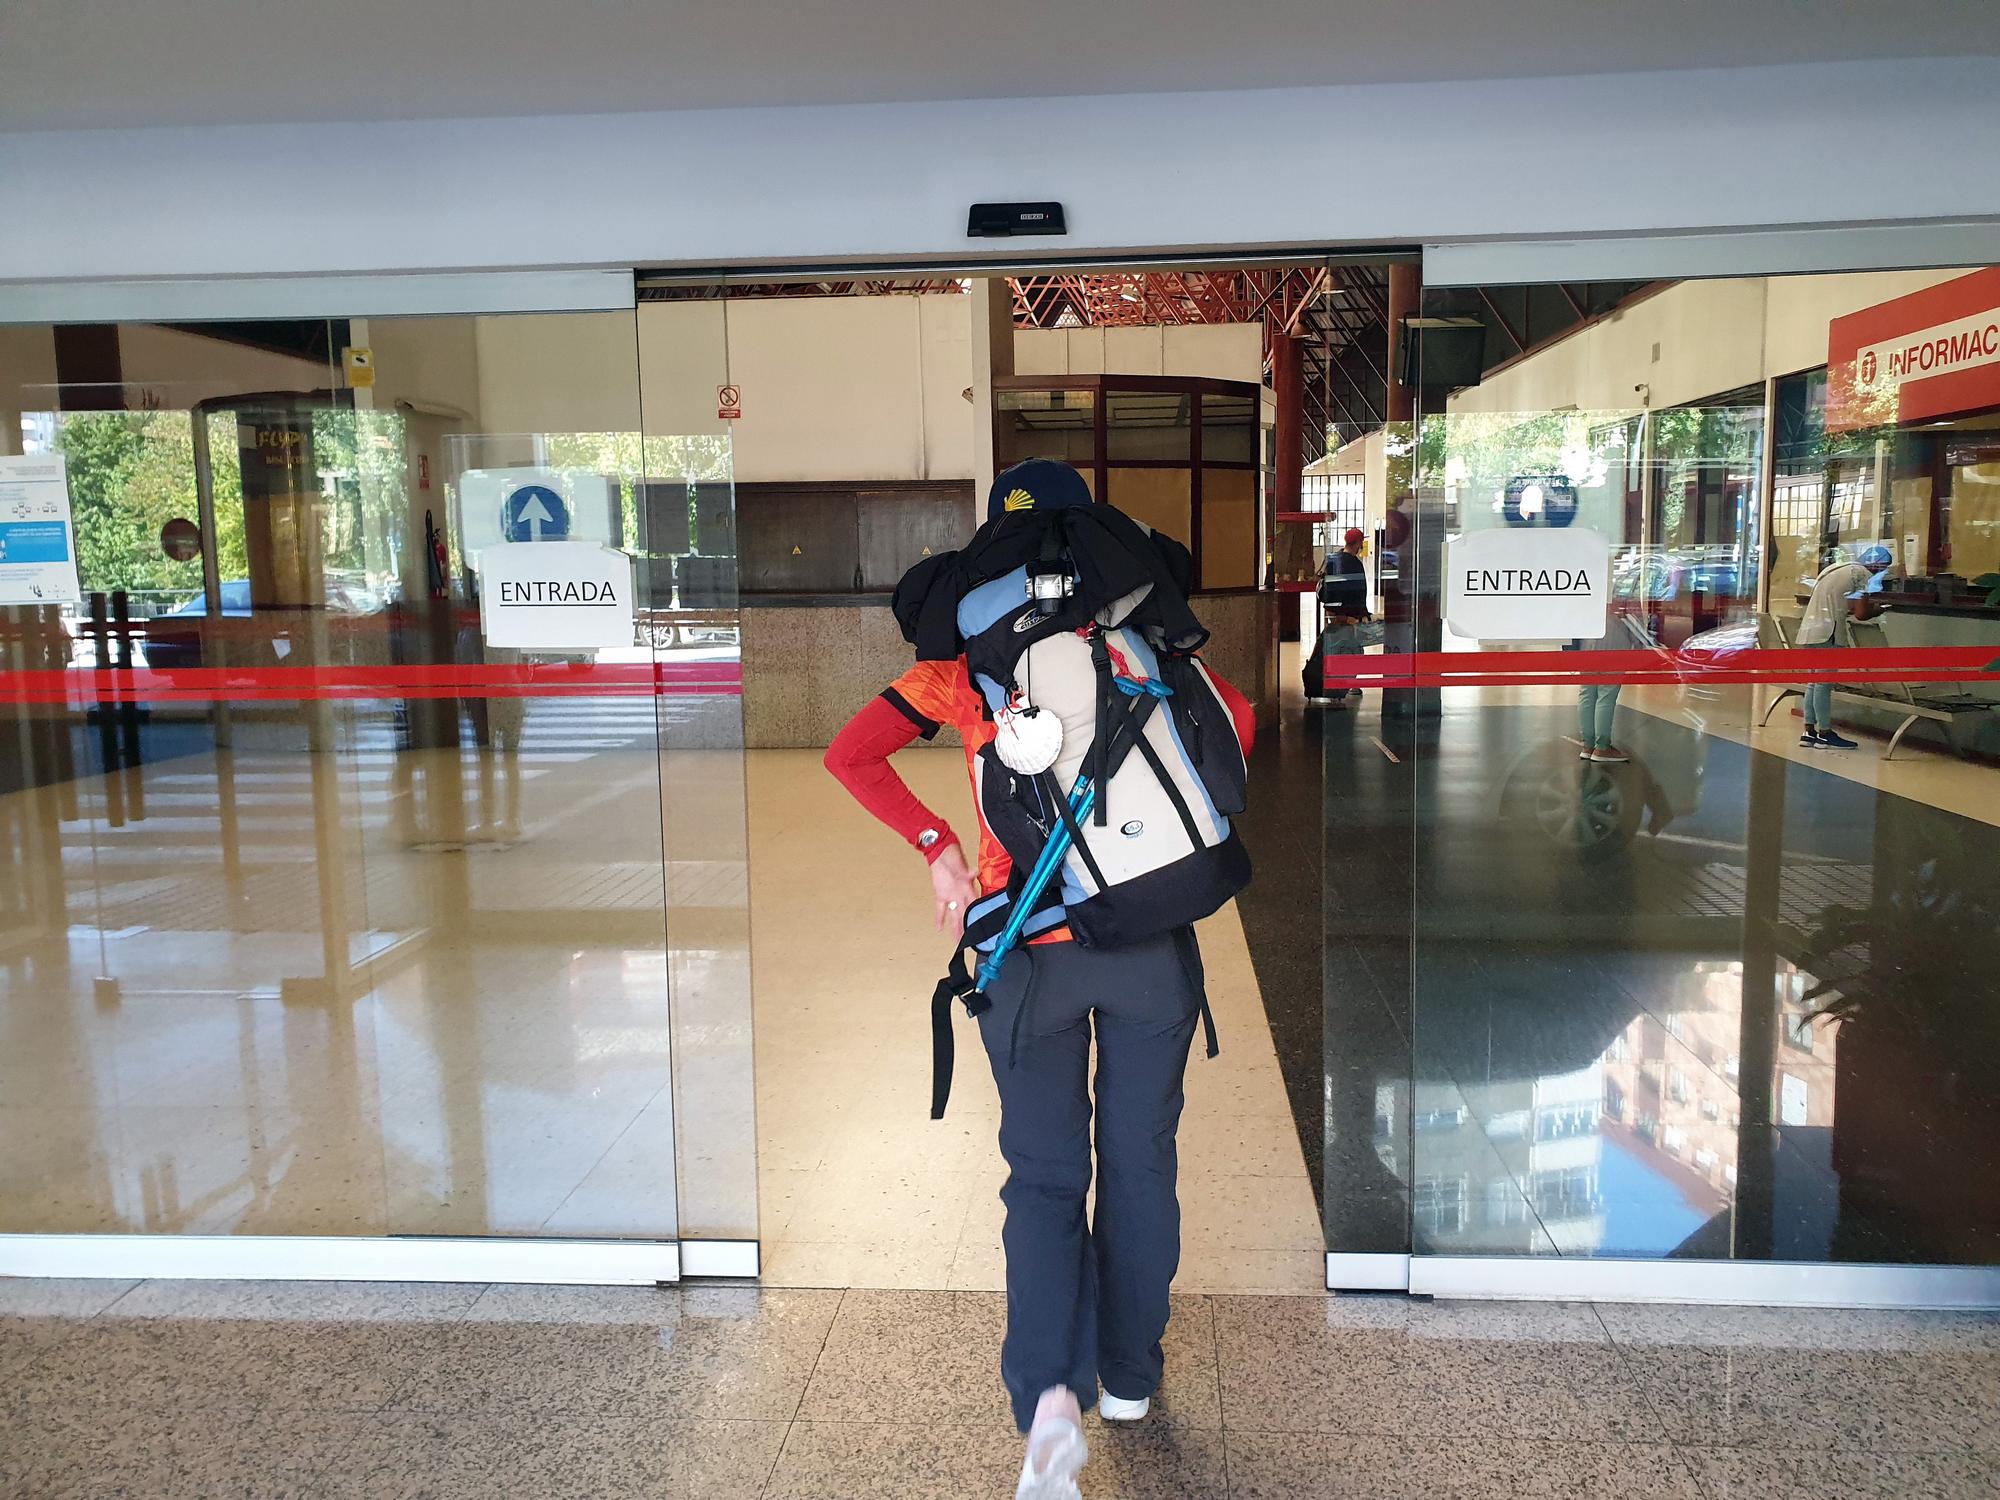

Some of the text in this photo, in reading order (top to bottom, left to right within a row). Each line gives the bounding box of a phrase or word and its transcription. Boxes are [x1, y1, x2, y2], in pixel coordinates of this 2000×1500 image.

[1889, 325, 1999, 376] INFORMAC
[501, 581, 616, 601] ENTRADA
[1466, 569, 1591, 591] ENTRADA
